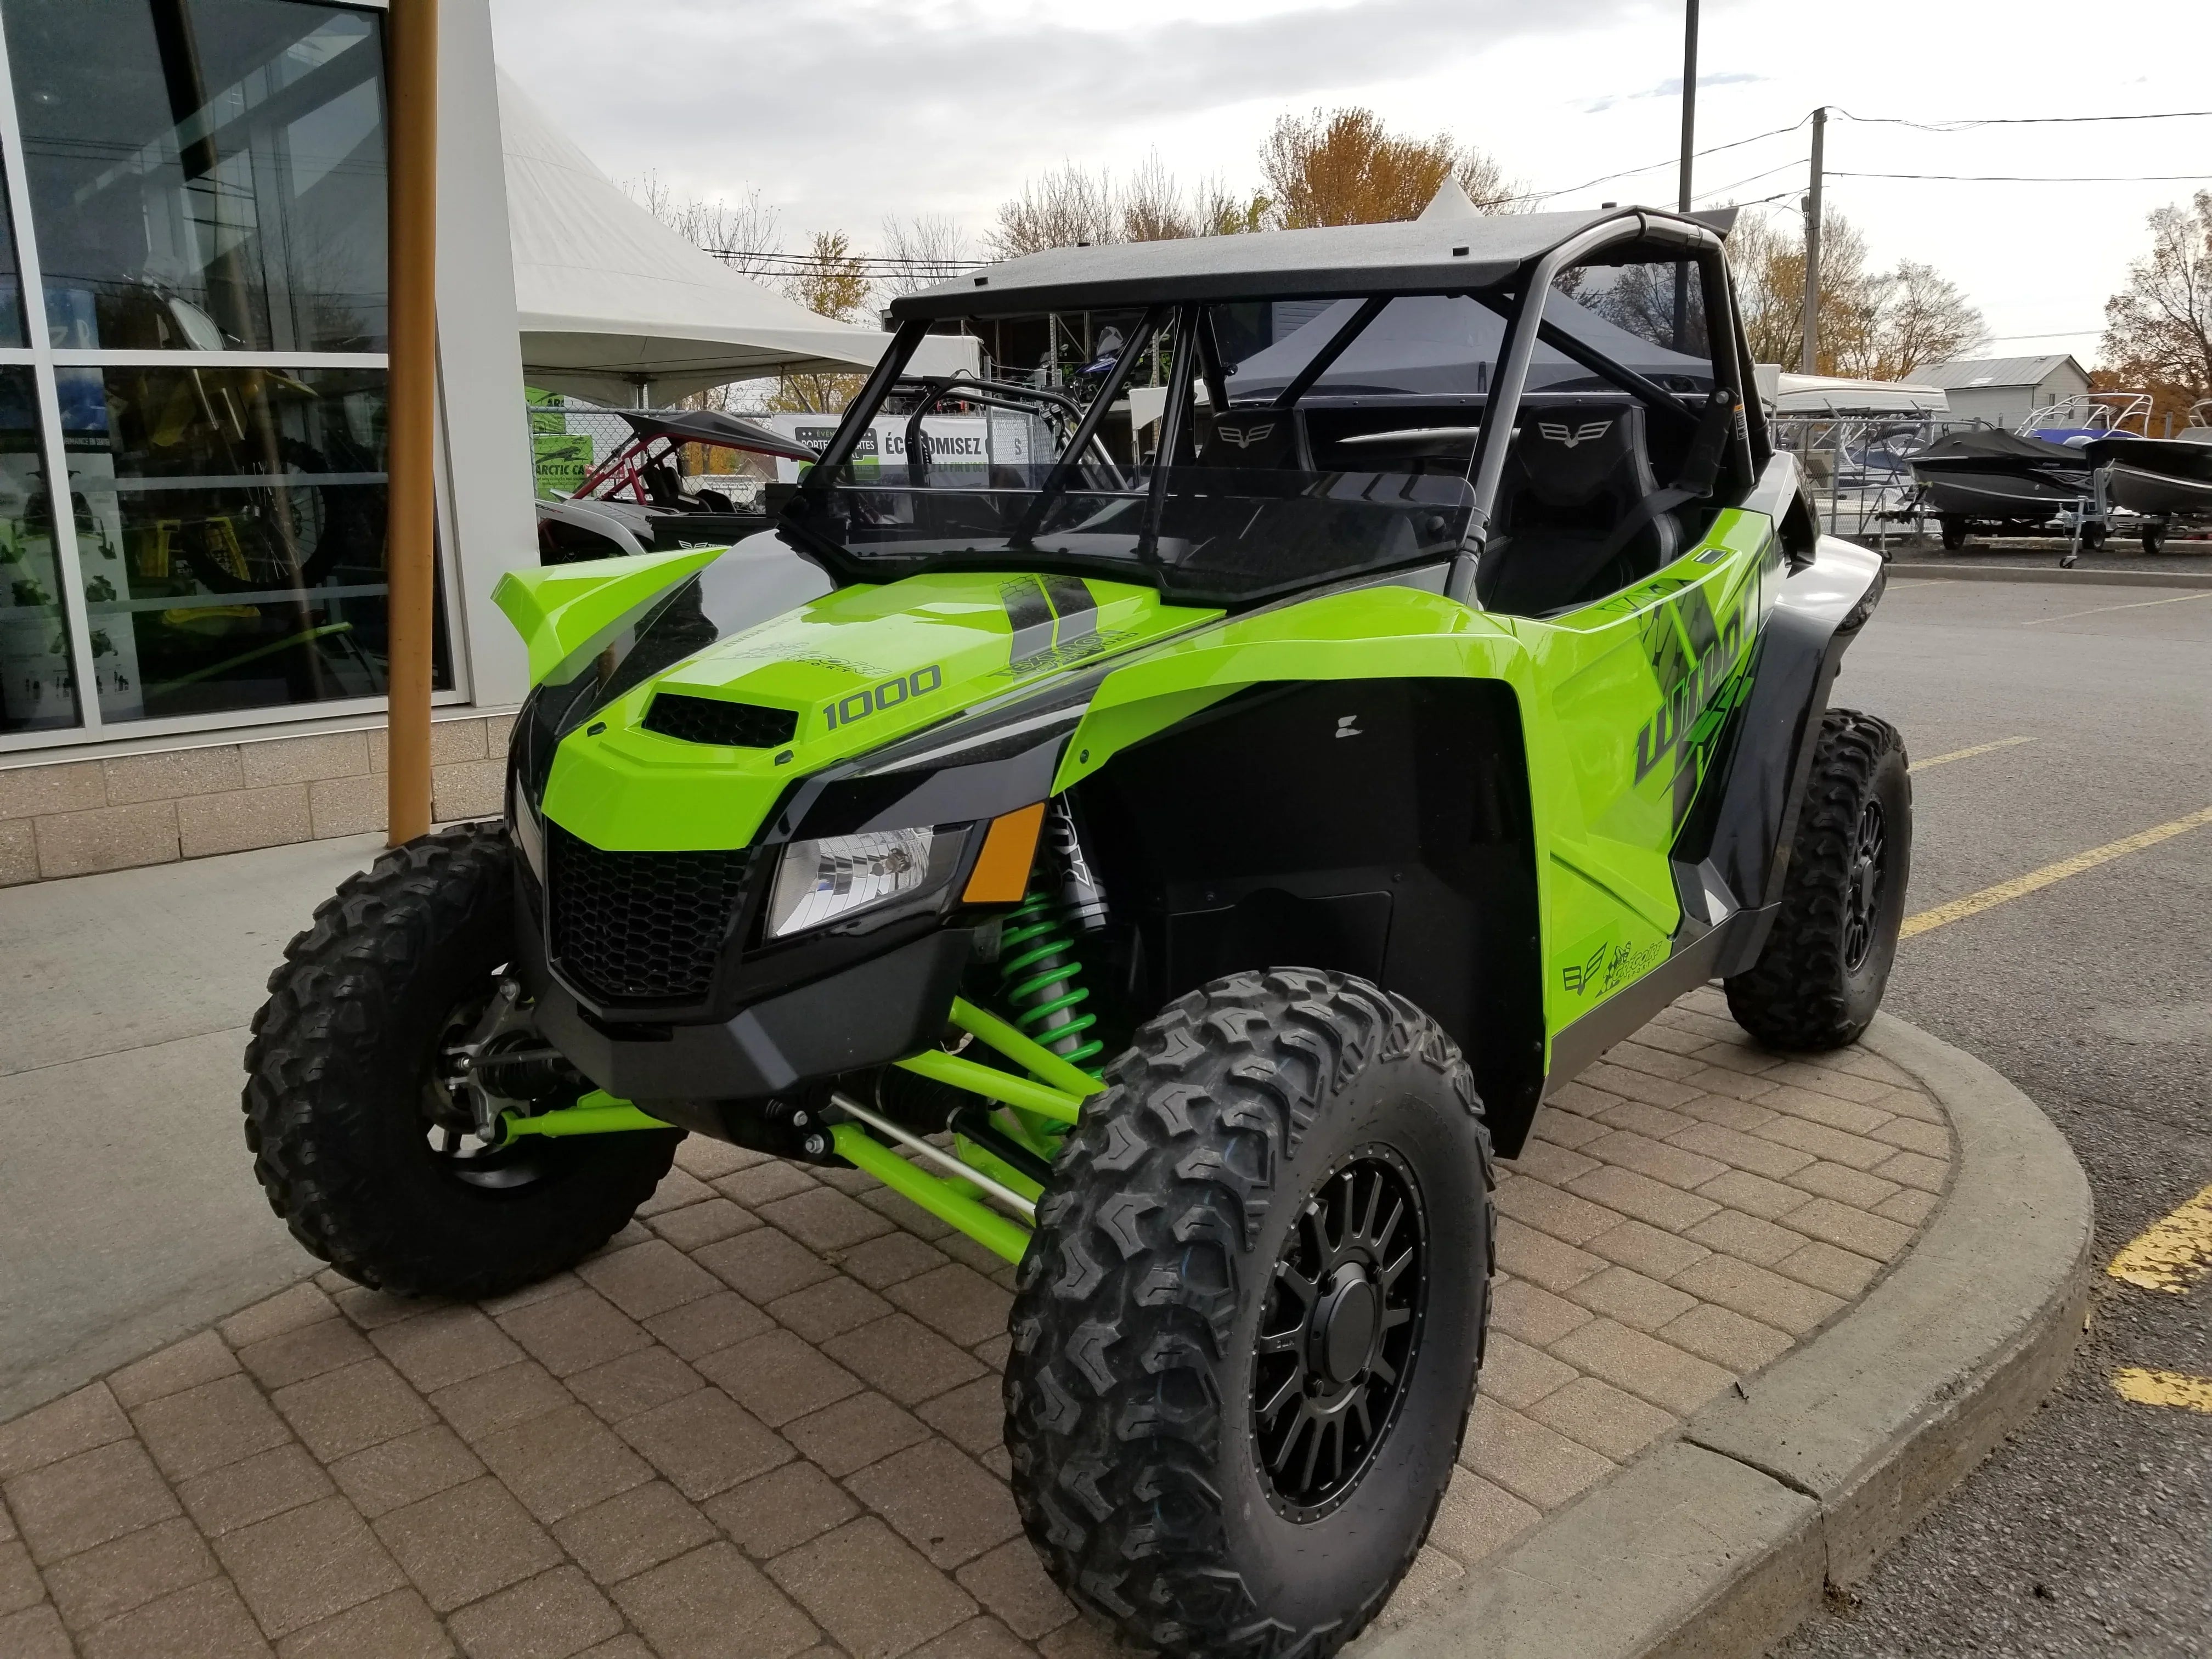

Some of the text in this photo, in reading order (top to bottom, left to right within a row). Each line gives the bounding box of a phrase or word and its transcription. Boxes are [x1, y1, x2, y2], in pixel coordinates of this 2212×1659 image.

[535, 465, 567, 475] ARCTIC
[572, 465, 585, 475] CA
[965, 462, 987, 472] D'OCT
[823, 664, 942, 731] 1000
